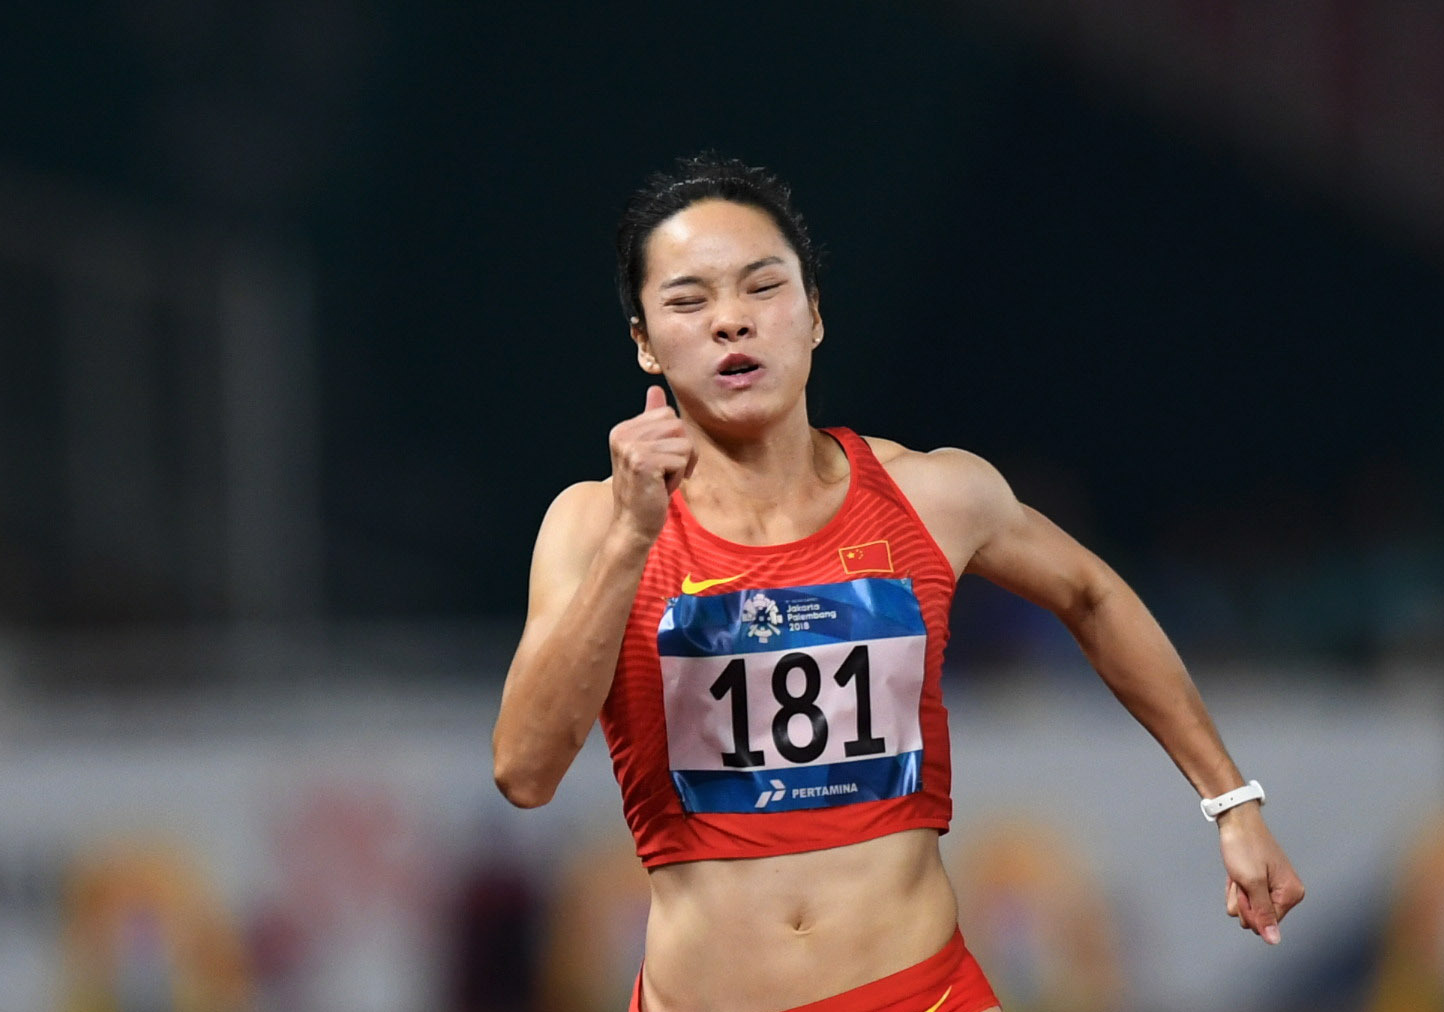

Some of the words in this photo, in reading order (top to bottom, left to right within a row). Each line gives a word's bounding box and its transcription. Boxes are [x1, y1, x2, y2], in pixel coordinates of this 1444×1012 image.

[786, 603, 821, 613] Jakarta
[787, 610, 837, 622] Palembang
[789, 621, 810, 632] 2018
[709, 645, 886, 768] 181
[791, 782, 858, 799] PERTAMINA
